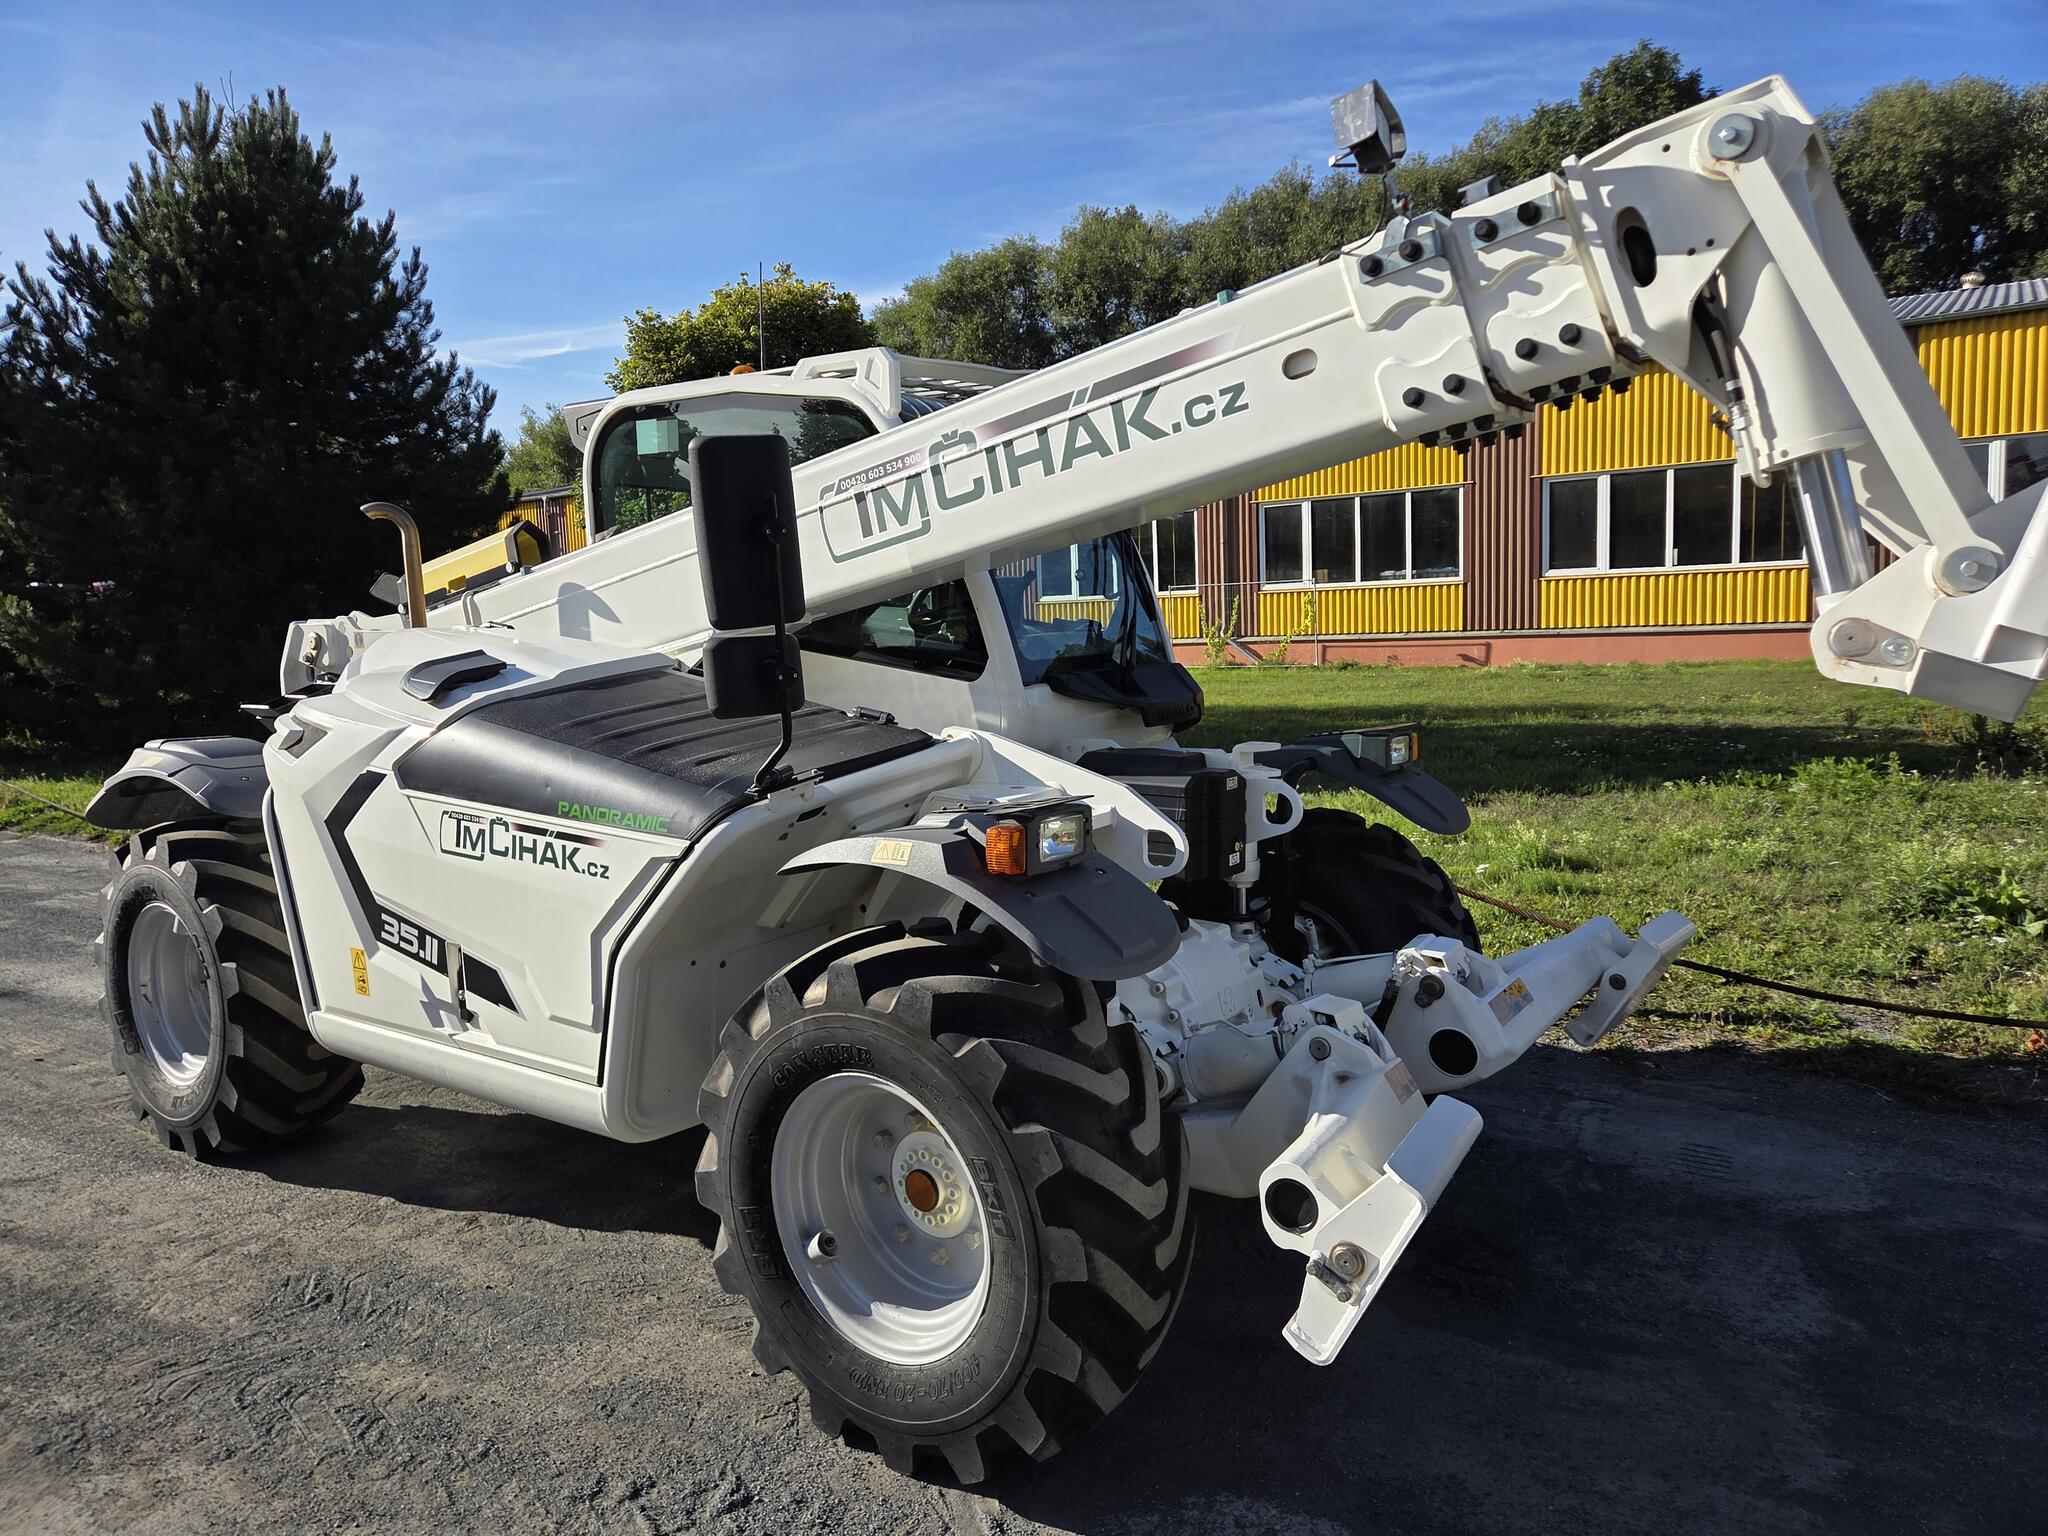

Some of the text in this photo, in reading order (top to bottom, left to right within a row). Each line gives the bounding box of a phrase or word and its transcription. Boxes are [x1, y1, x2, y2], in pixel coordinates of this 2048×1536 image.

[840, 453, 921, 490] 00420 603 534 900
[557, 801, 671, 833] PANORAMIC
